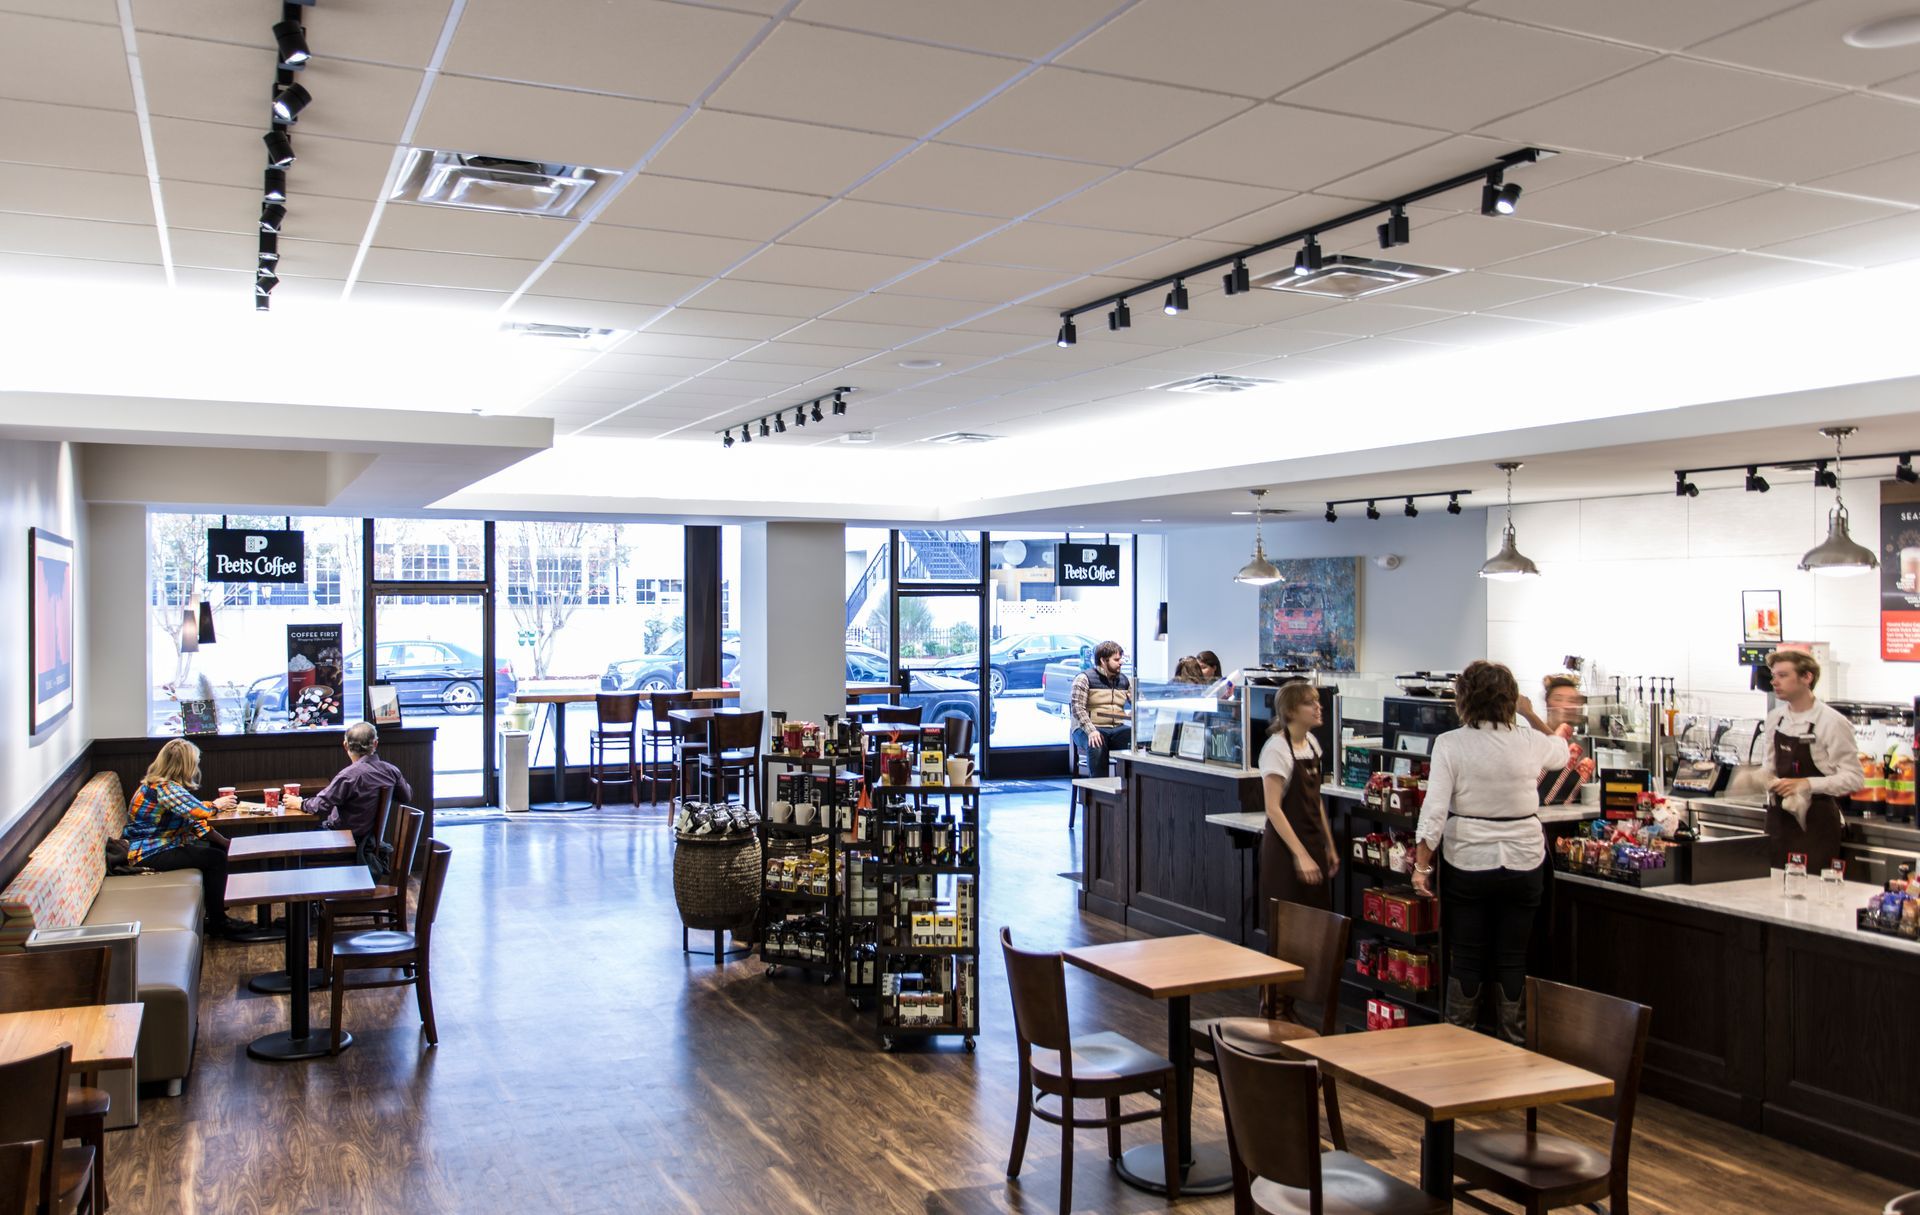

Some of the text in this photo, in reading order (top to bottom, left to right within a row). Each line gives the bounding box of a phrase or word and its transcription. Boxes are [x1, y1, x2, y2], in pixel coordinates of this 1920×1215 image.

[1901, 512, 1920, 521] SEA
[215, 554, 297, 577] Peet's Coffee
[1063, 563, 1116, 582] Peet's Coffee
